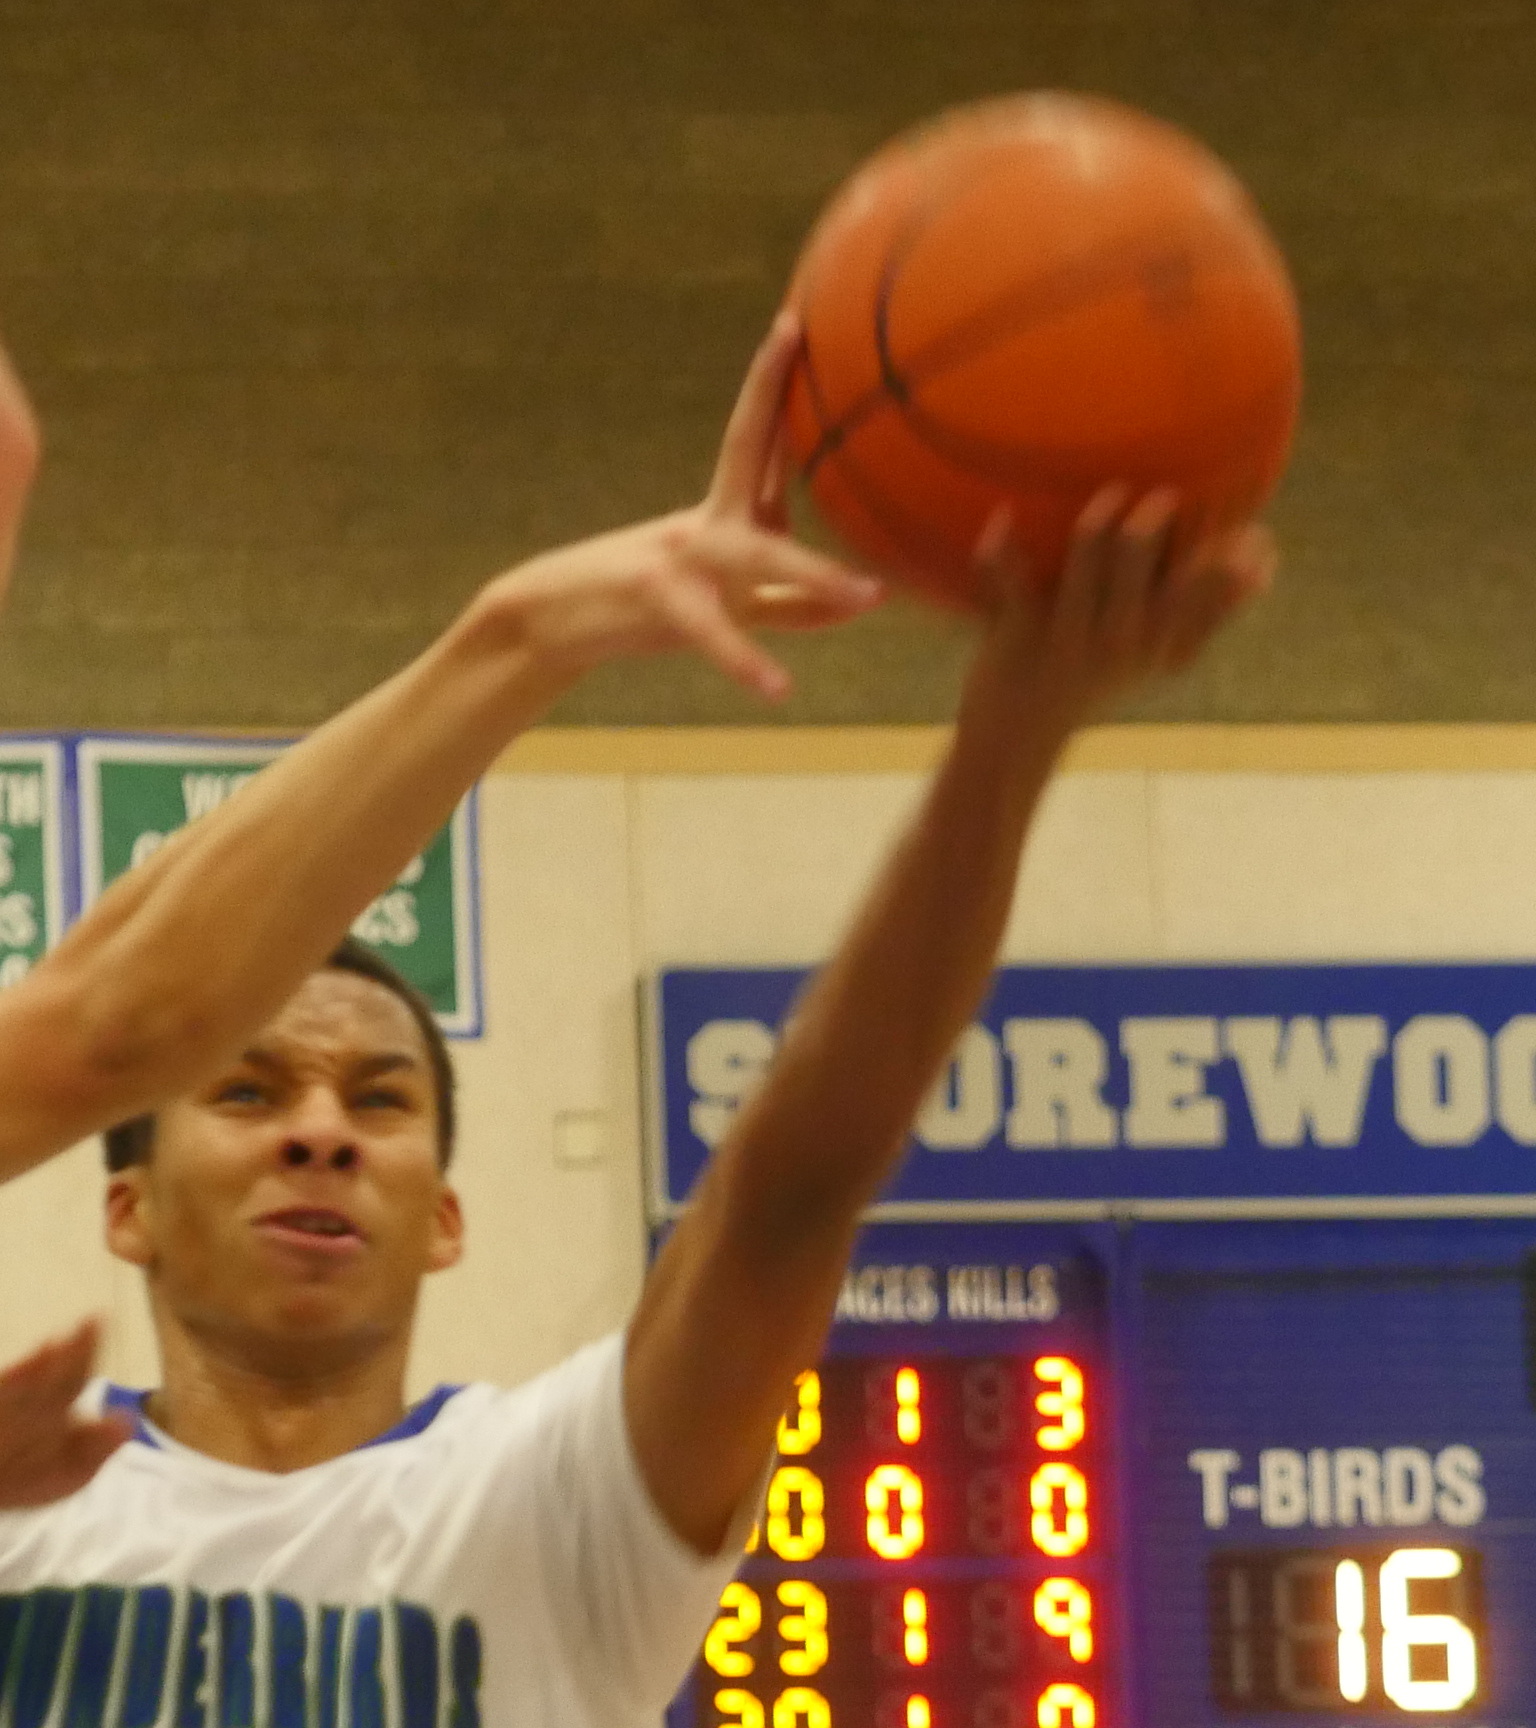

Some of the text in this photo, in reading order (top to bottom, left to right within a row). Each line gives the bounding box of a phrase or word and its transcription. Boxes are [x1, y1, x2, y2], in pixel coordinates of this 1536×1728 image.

[946, 1264, 1059, 1323] KILLS
[895, 1365, 921, 1446] 1
[1033, 1354, 1085, 1452] 3
[745, 1461, 1089, 1562] 0 0 0
[1189, 1445, 1486, 1529] T-BIRDS
[704, 1576, 1093, 1677] 23 1 9
[1334, 1546, 1478, 1713] 16
